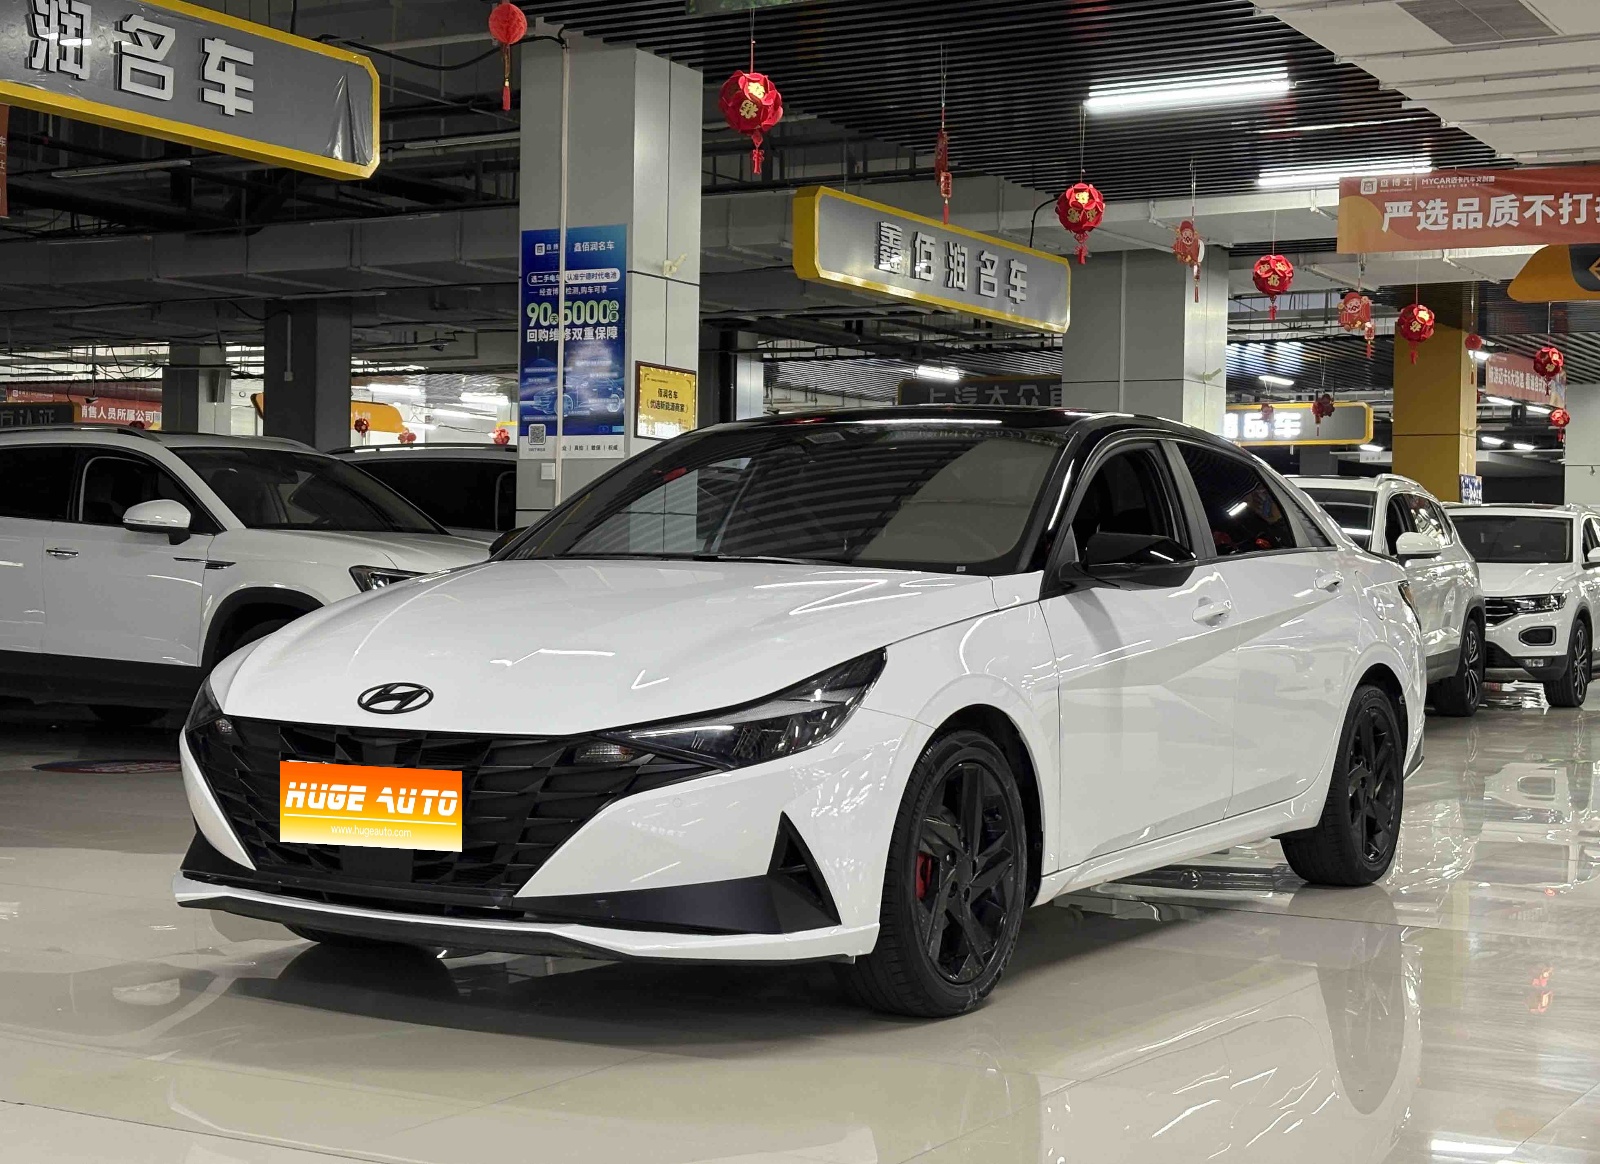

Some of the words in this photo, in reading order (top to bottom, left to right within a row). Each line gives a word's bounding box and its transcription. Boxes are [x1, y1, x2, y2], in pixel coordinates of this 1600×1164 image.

[27, 0, 255, 117] 润名车
[573, 240, 615, 253] 鑫佰润名车
[876, 220, 1028, 305] 鑫佰润名车
[538, 285, 608, 296] 经查博检测,购车可享
[526, 325, 619, 343] 回购维修双重保障
